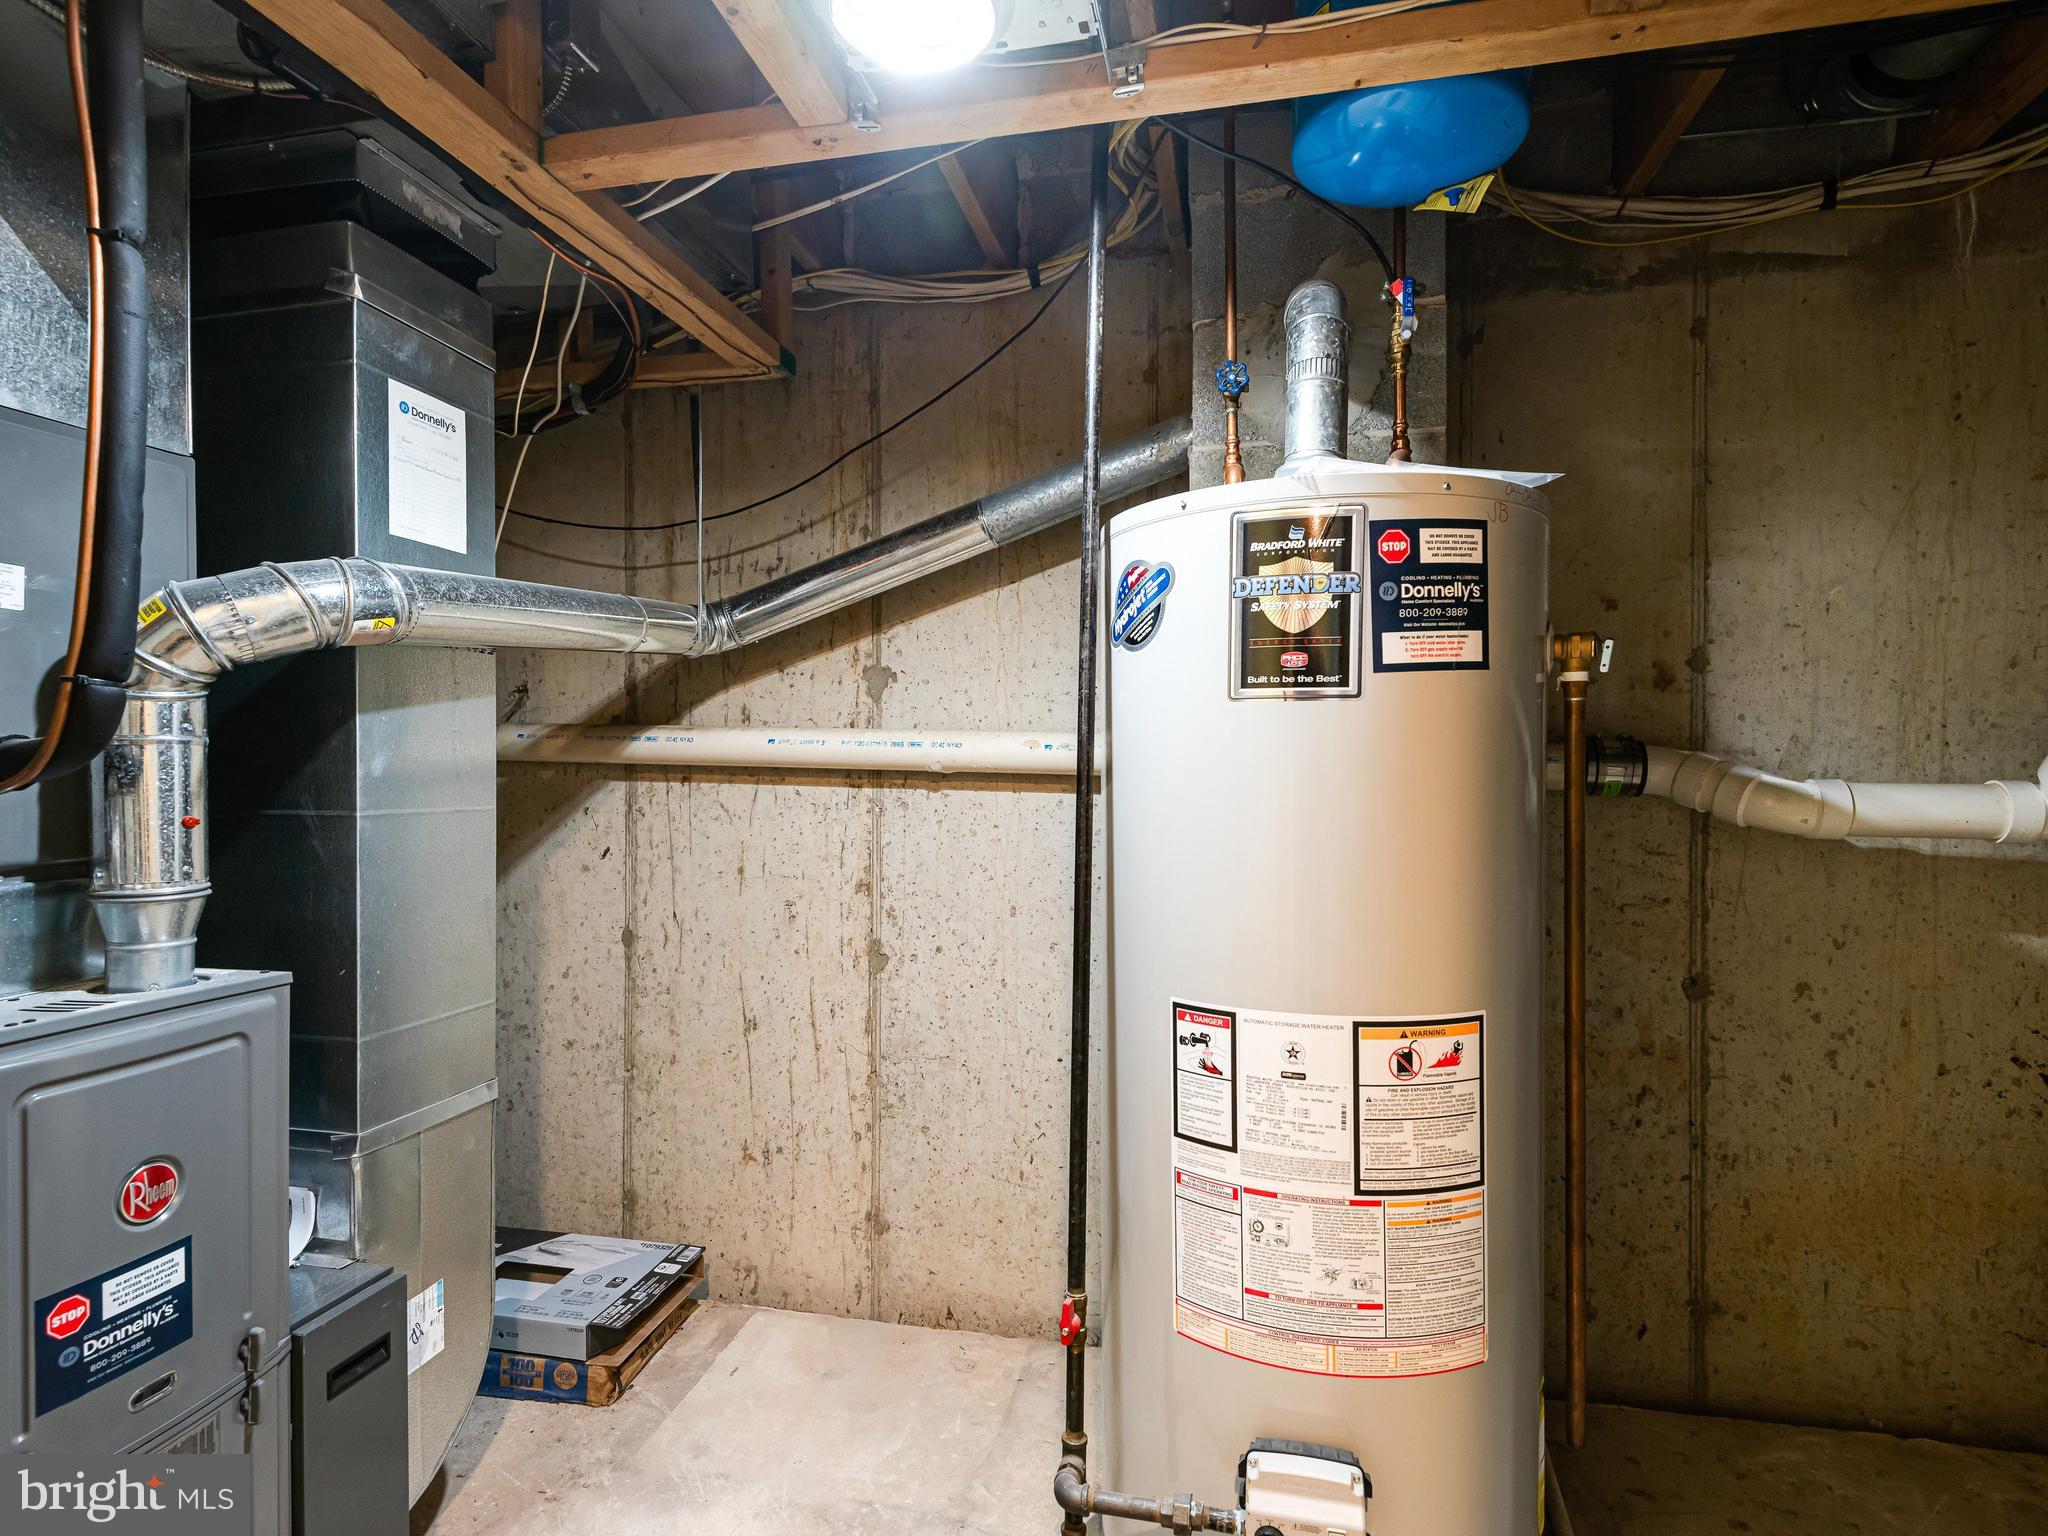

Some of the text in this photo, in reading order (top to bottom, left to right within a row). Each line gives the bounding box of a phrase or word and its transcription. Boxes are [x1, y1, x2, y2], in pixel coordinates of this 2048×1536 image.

[412, 406, 457, 432] Donnelly's
[1250, 538, 1344, 552] BRADFORD WHITE
[1256, 548, 1335, 557] CORPORATION
[1381, 541, 1407, 552] STOP
[1233, 571, 1361, 598] DEFENDER
[1401, 581, 1480, 602] Donnelly's
[1250, 600, 1339, 612] SAFETY SYSTEM
[1399, 607, 1468, 618] 800-209-3889
[1248, 675, 1268, 683] Built
[1193, 1014, 1224, 1026] DANGER
[1243, 1018, 1273, 1026] AUTOMATIC
[1275, 1021, 1300, 1029] STORAGE
[1410, 1029, 1446, 1037] WARNING
[130, 1171, 175, 1217] Rheem
[134, 1269, 152, 1280] REMOVE
[160, 1258, 174, 1268] COVER
[51, 1305, 86, 1329] STOP
[84, 1295, 172, 1340] COOLING HEATING PLUMBING
[84, 1304, 174, 1357] Donnelly's
[90, 1337, 152, 1372] 800-209-3889
